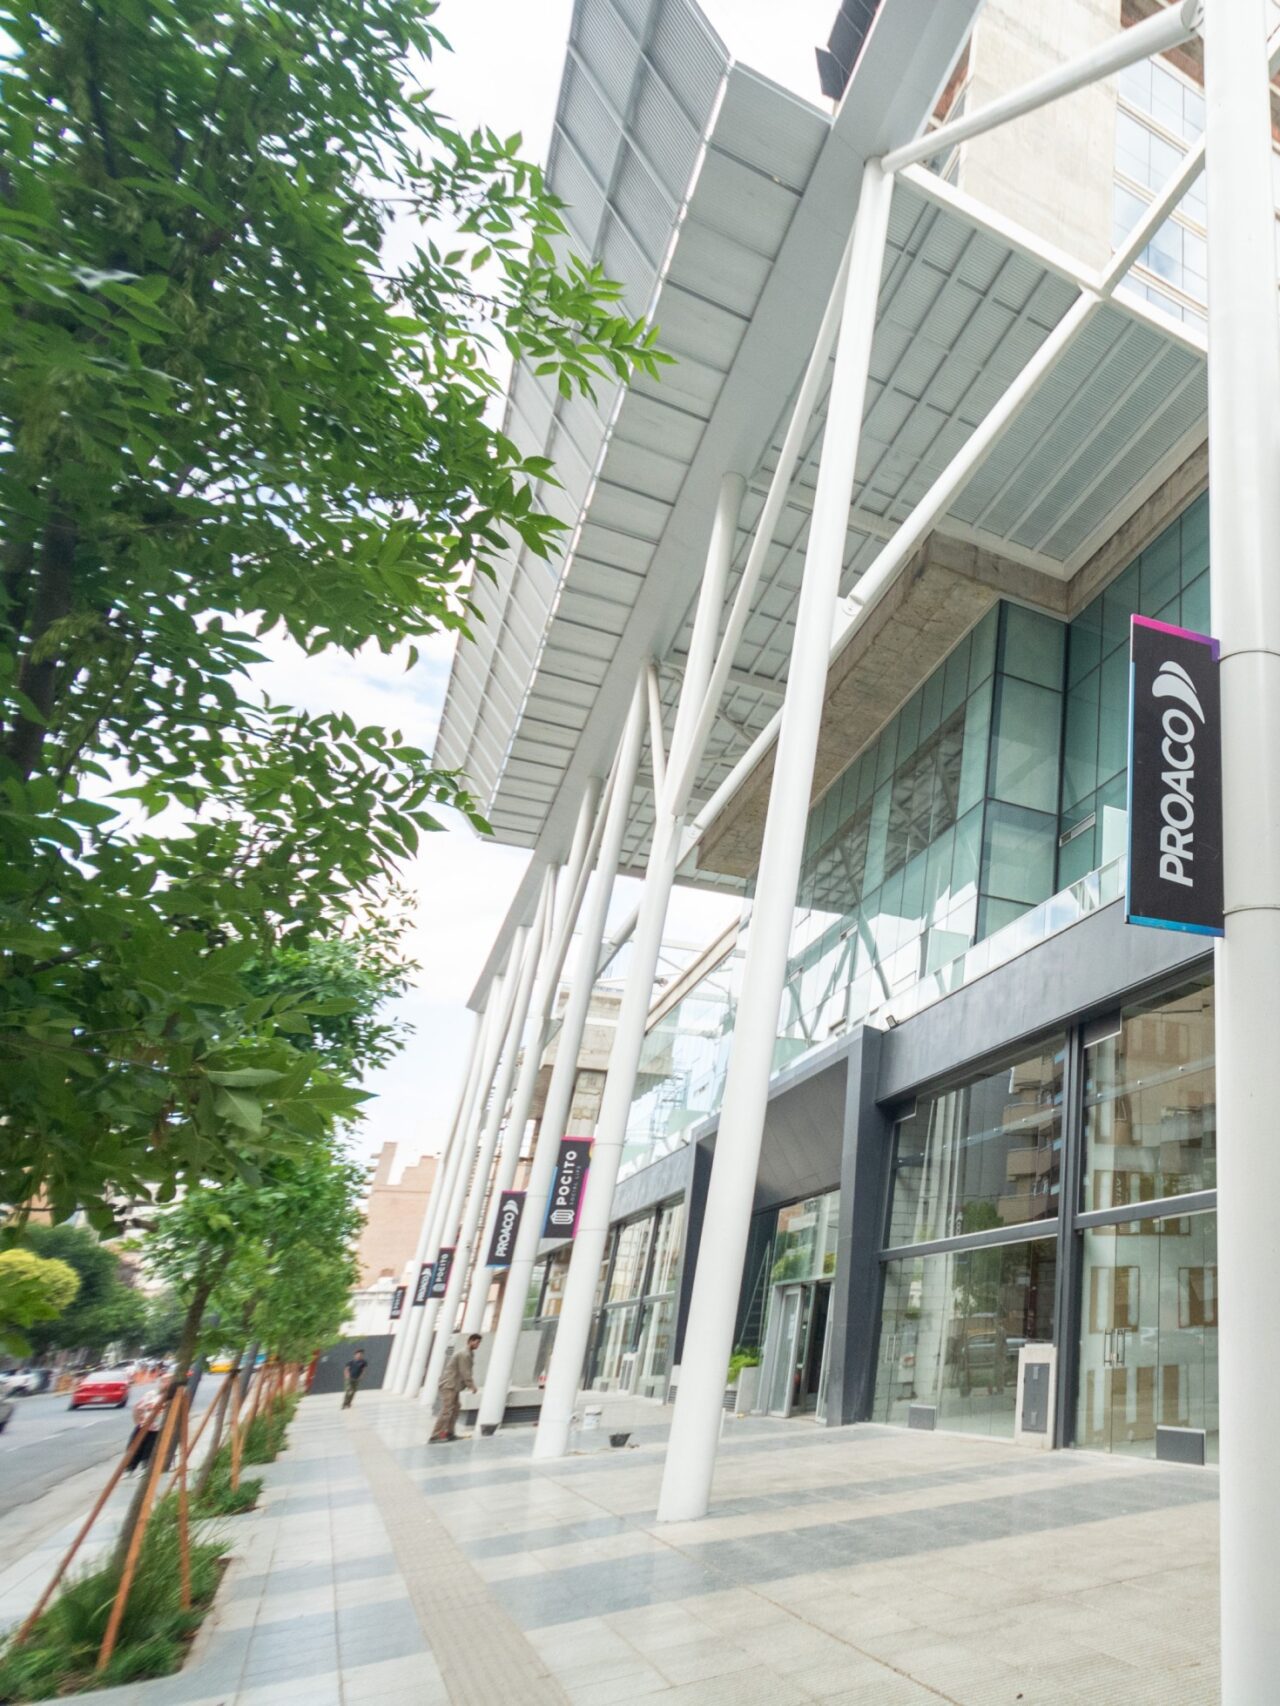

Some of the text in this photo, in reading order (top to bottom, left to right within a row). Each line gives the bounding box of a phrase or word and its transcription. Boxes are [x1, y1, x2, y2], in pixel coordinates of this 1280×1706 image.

[1159, 708, 1195, 887] PROACO
[556, 1150, 577, 1206] POCITO
[495, 1212, 515, 1257] PROACO
[435, 1253, 449, 1282] POCITO
